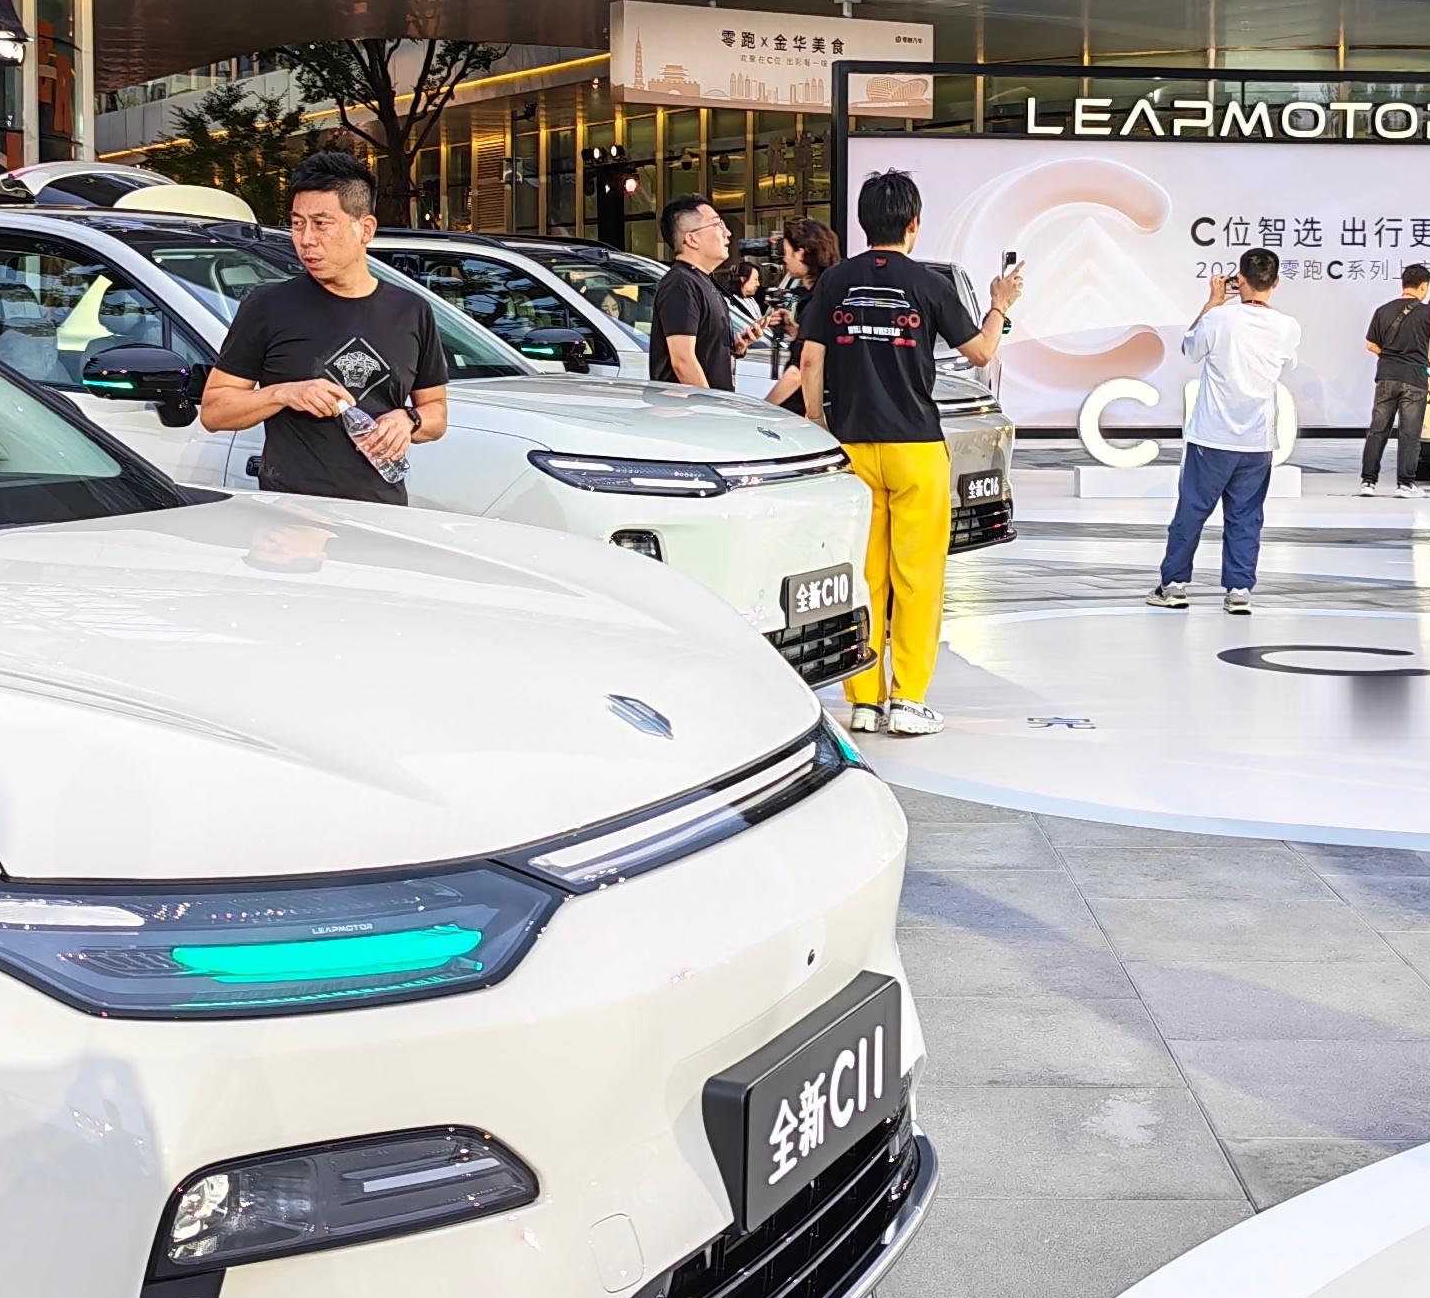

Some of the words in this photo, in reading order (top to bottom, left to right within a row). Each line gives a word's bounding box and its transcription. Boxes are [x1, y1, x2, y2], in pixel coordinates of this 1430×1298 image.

[1190, 216, 1323, 248] C位智选
[968, 476, 999, 499] 全新C16
[795, 573, 849, 613] 全新C10
[769, 1025, 884, 1186] 全新C11
